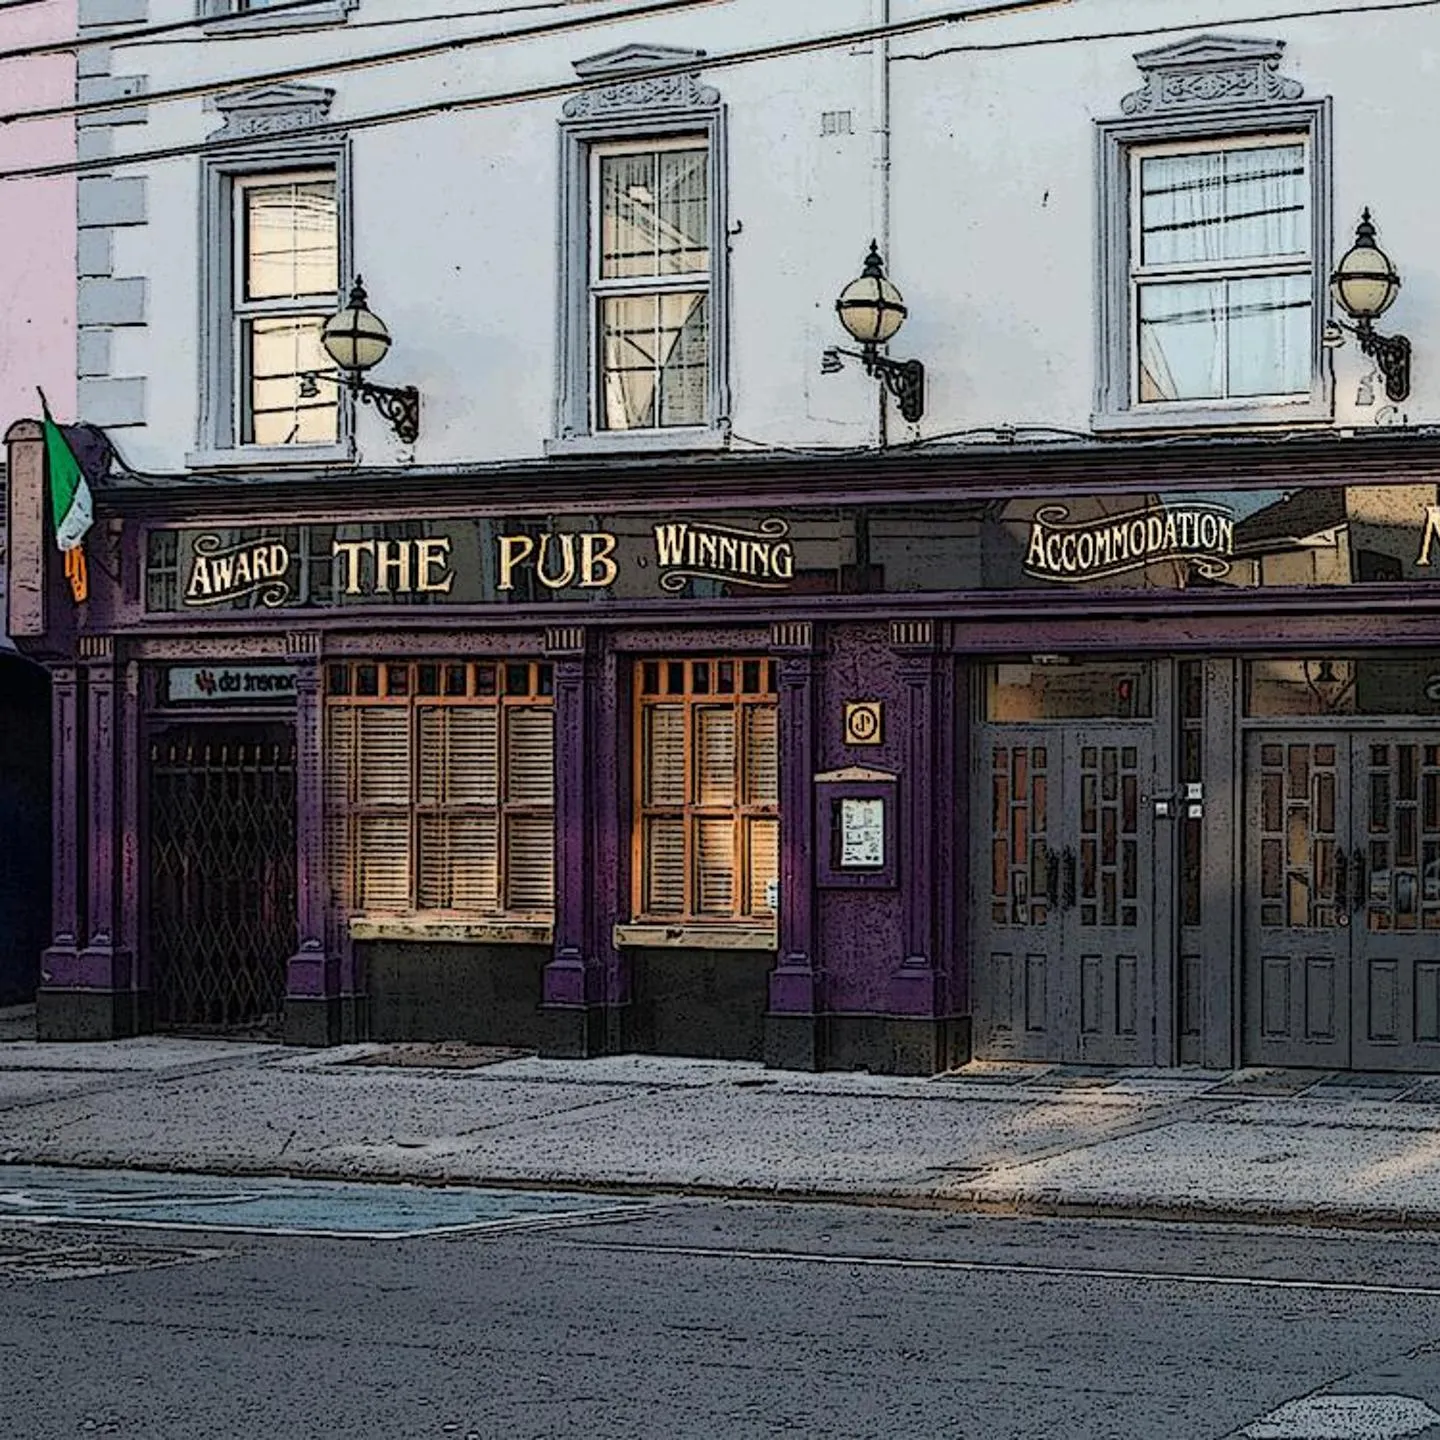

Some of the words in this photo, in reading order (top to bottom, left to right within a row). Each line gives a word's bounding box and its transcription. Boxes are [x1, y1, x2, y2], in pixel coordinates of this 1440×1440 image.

[186, 544, 289, 596] AWARD
[332, 537, 456, 594] THE
[496, 532, 619, 589] PUB
[653, 523, 794, 578] WINNING
[1025, 511, 1234, 572] ACCOMMODATION
